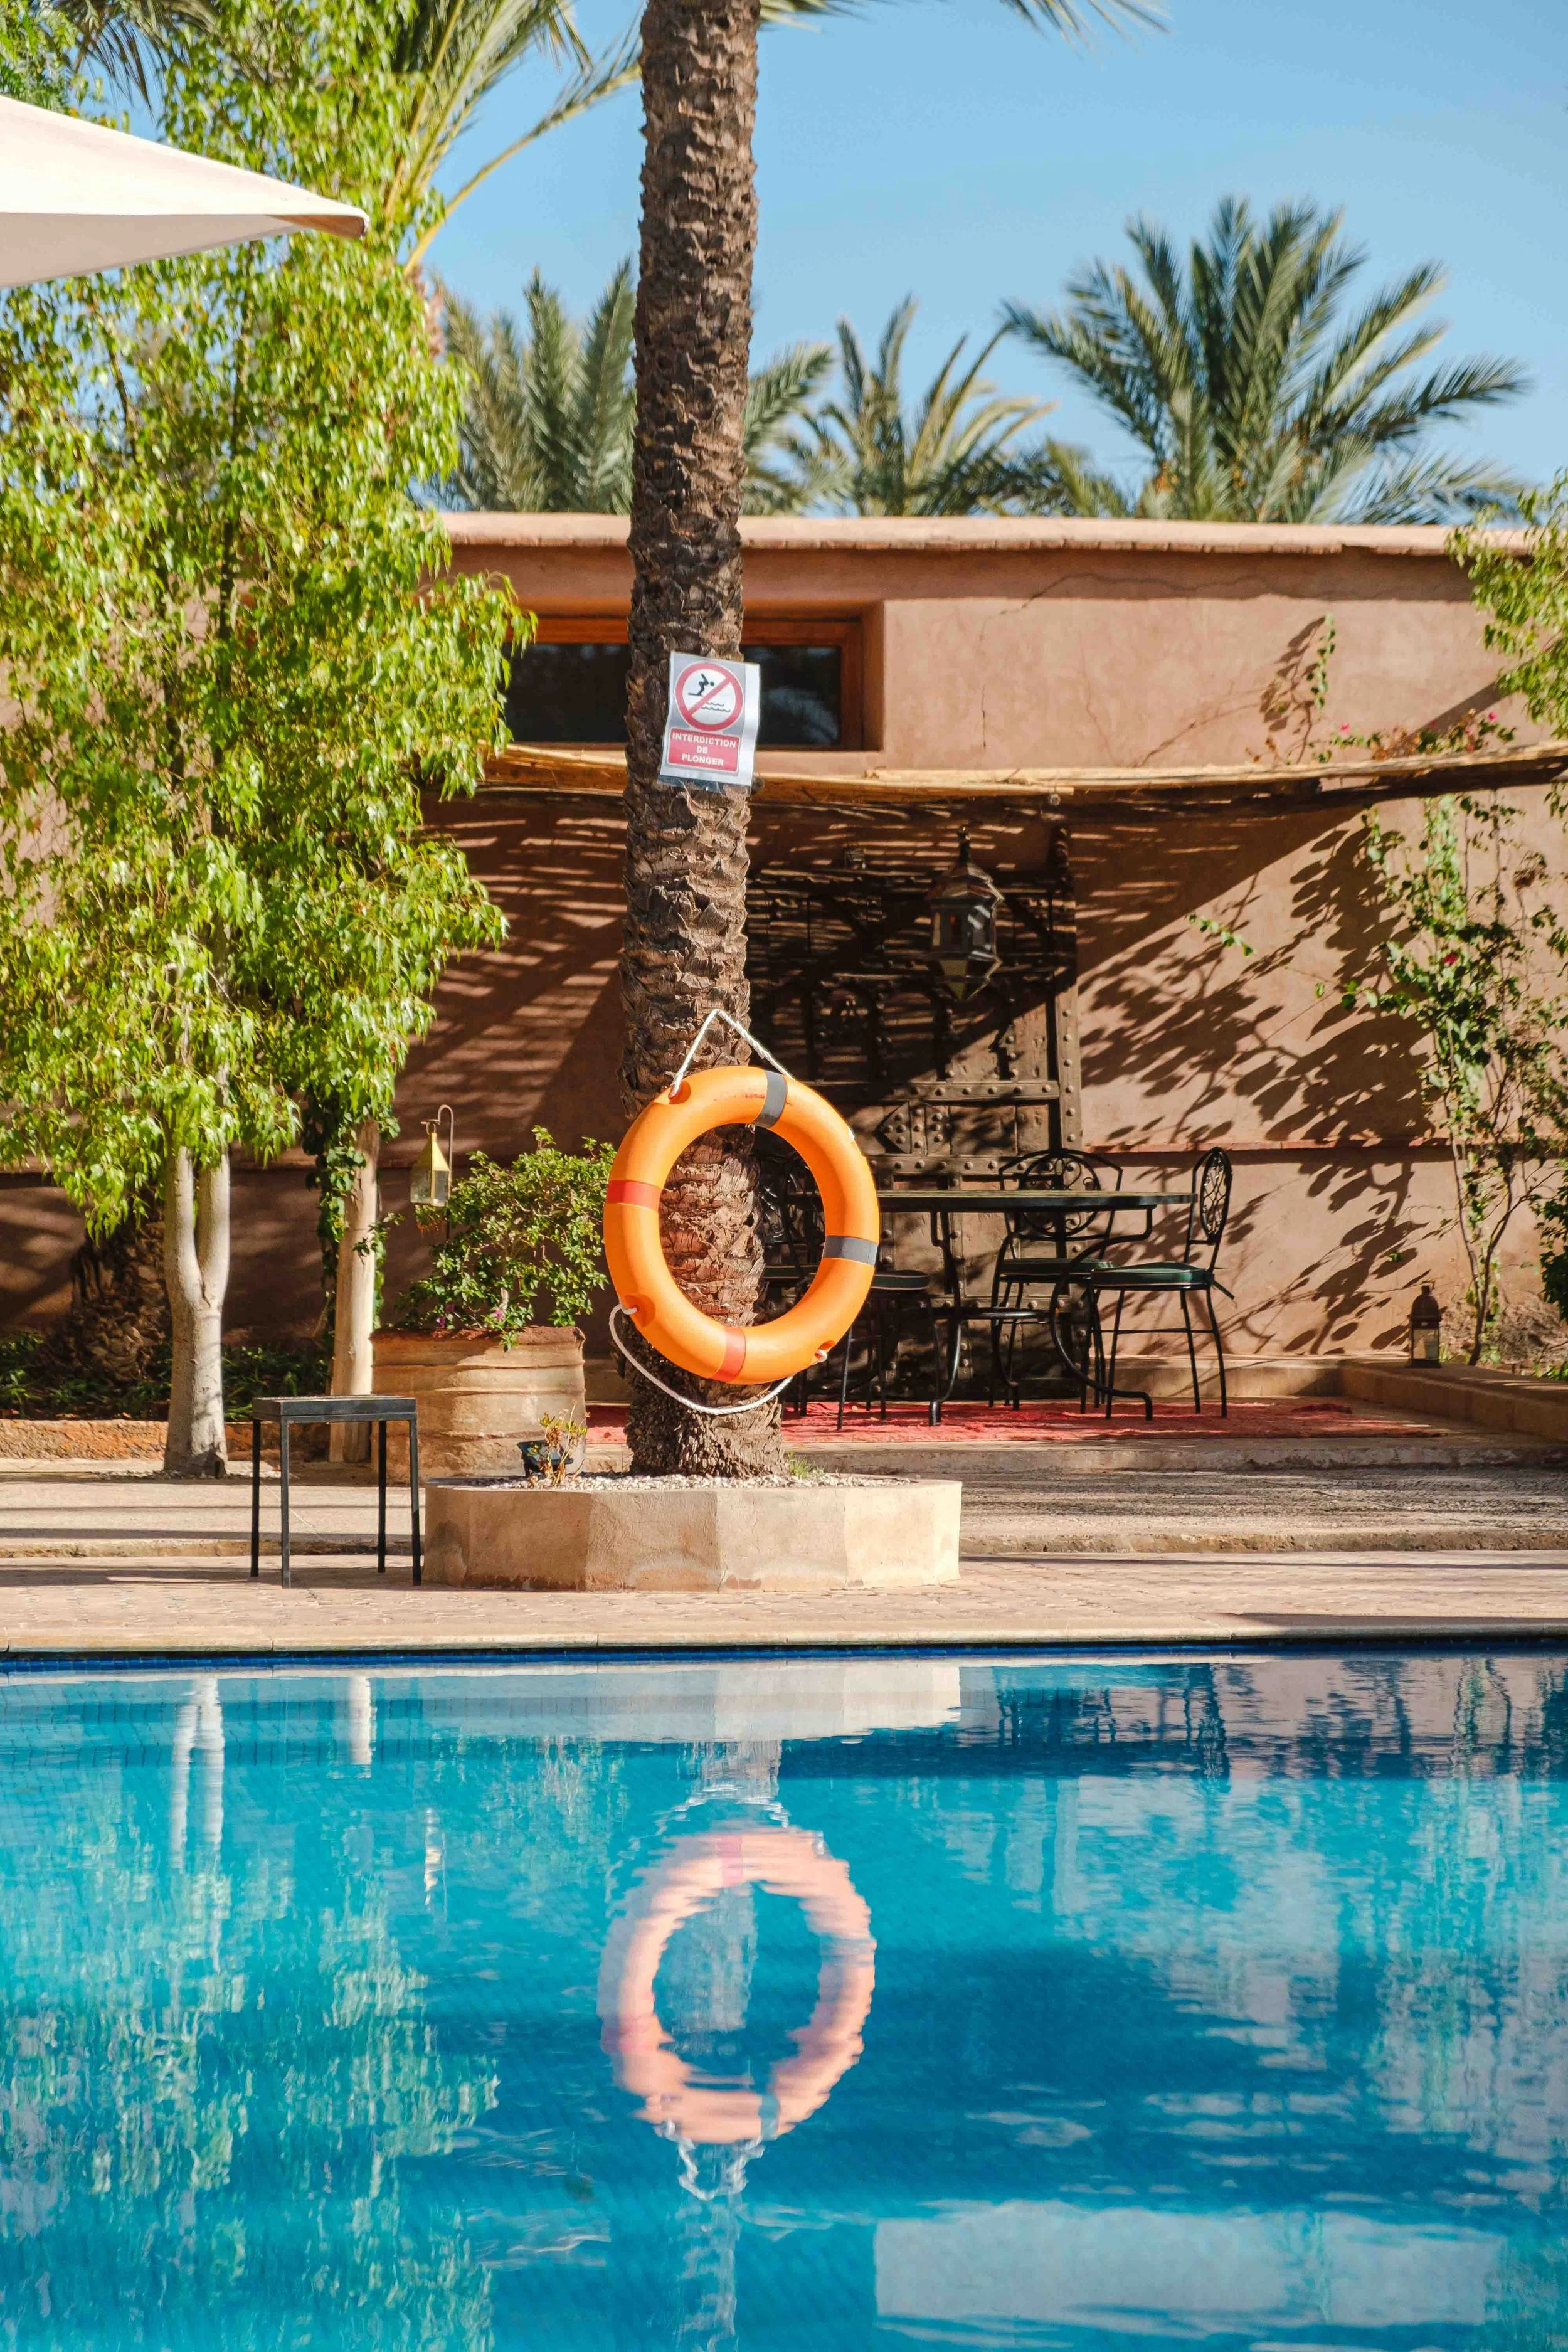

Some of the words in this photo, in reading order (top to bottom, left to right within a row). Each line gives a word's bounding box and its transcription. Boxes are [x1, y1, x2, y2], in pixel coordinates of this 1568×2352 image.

[672, 732, 736, 748] INTERDICTION
[696, 746, 708, 754] DE
[681, 753, 724, 766] PLONGER
